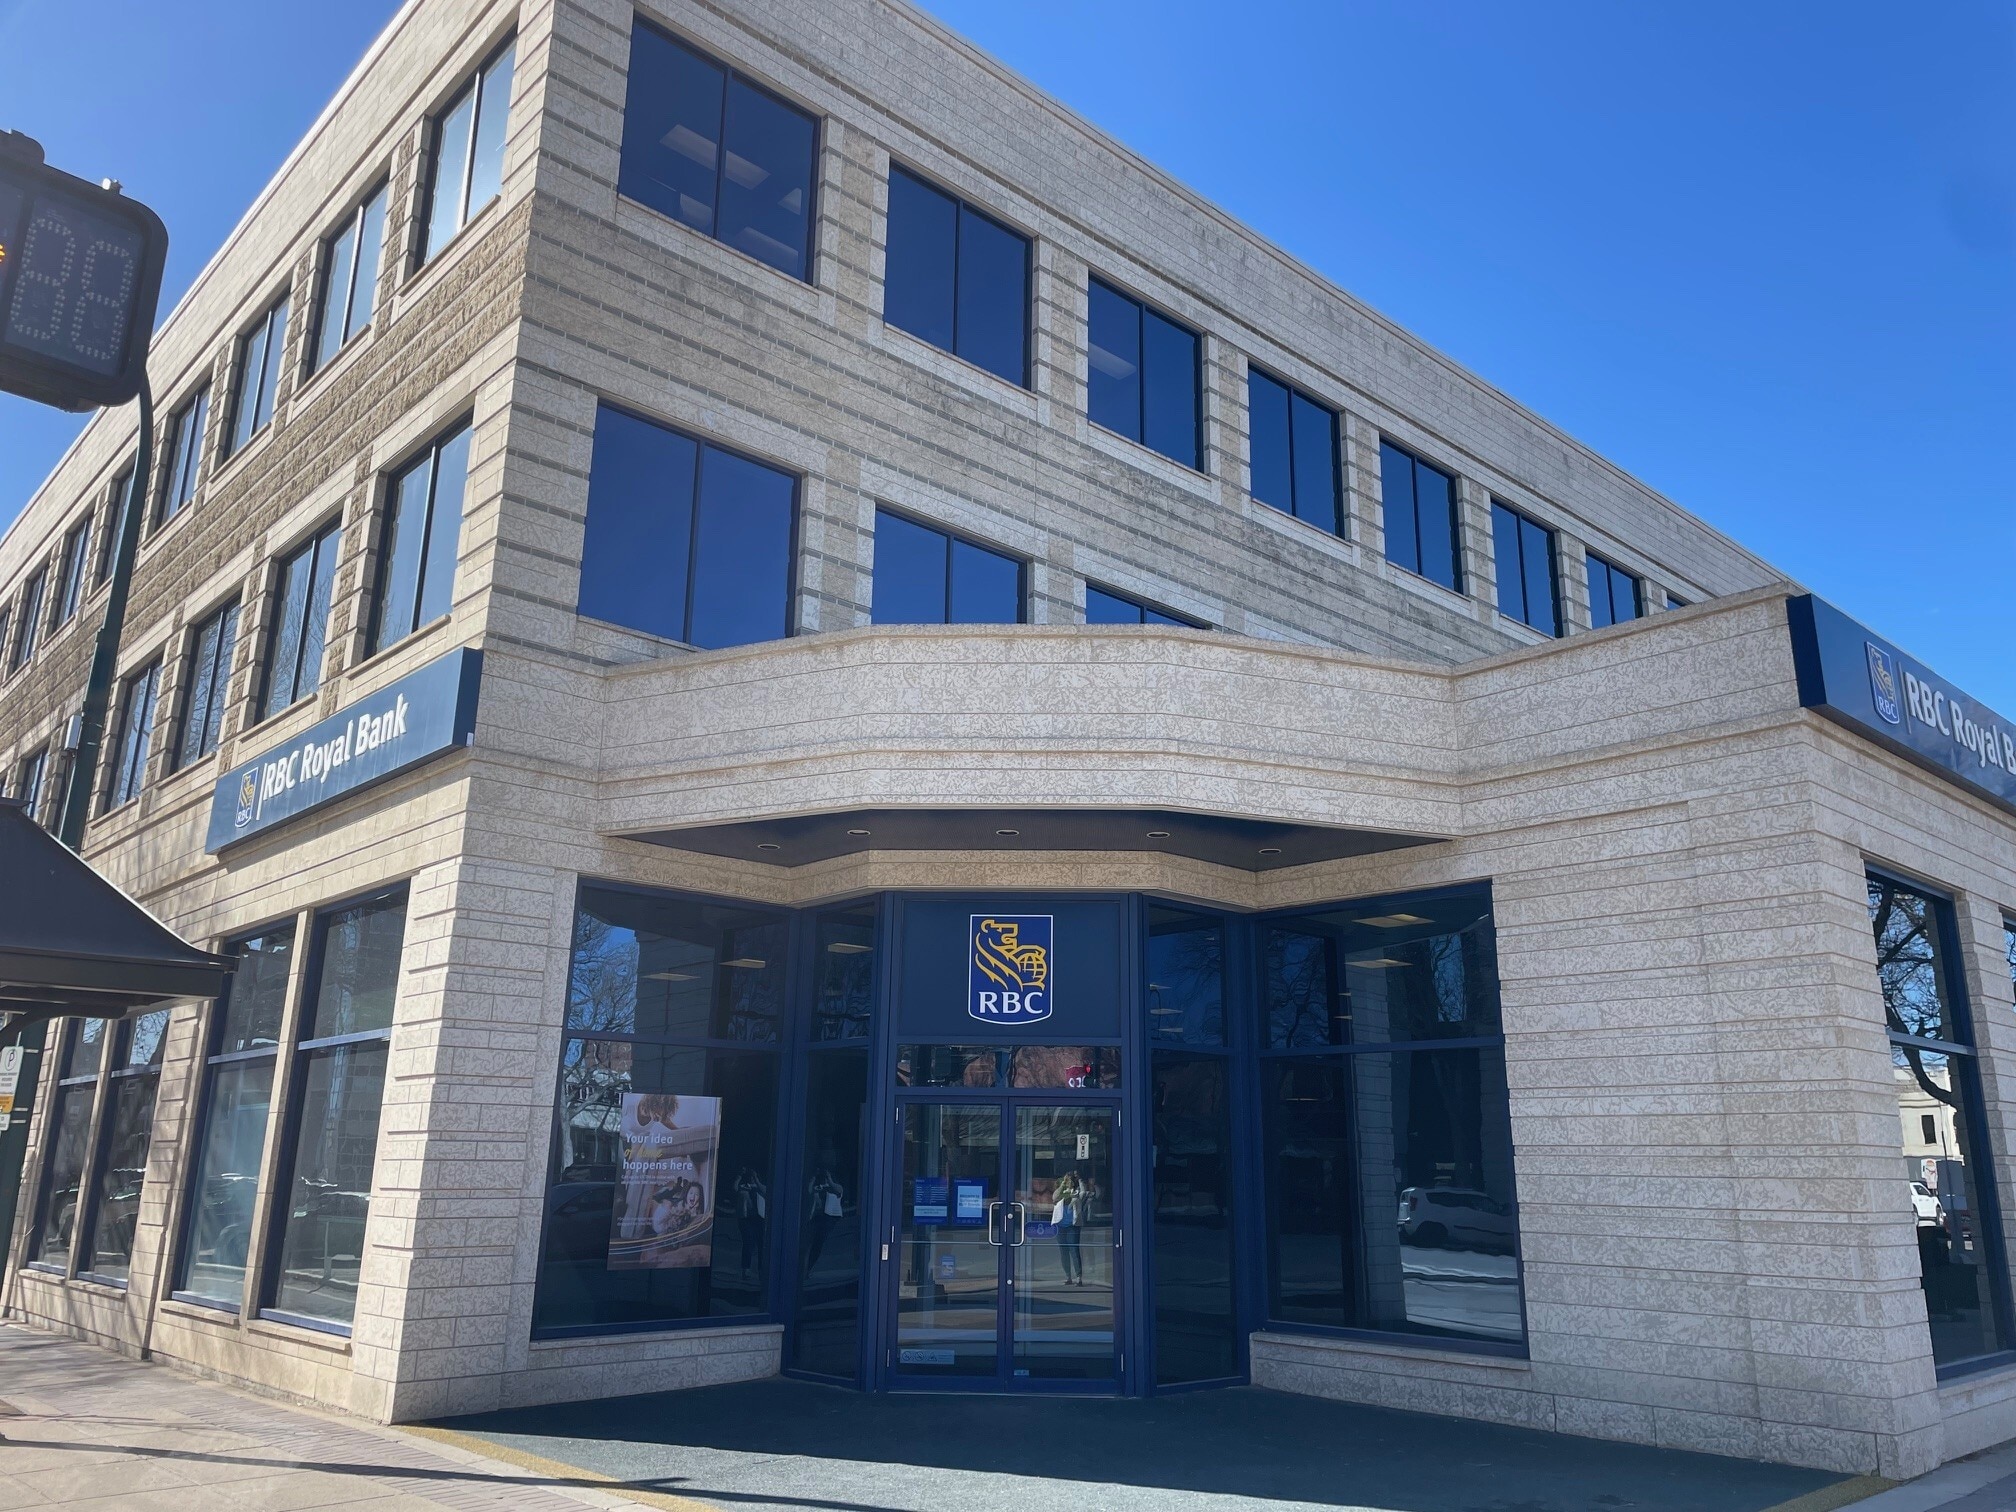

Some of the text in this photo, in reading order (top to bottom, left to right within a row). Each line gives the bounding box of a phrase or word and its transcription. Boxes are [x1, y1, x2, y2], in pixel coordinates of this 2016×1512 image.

[1878, 695, 1897, 719] RBC
[1904, 671, 1950, 737] RBC
[1950, 699, 2004, 768] Royal
[262, 692, 409, 801] RBC Royal Bank
[237, 807, 251, 823] RBC
[978, 991, 1043, 1014] RBC
[625, 1133, 673, 1144] Your idea
[622, 1158, 693, 1173] happens here
